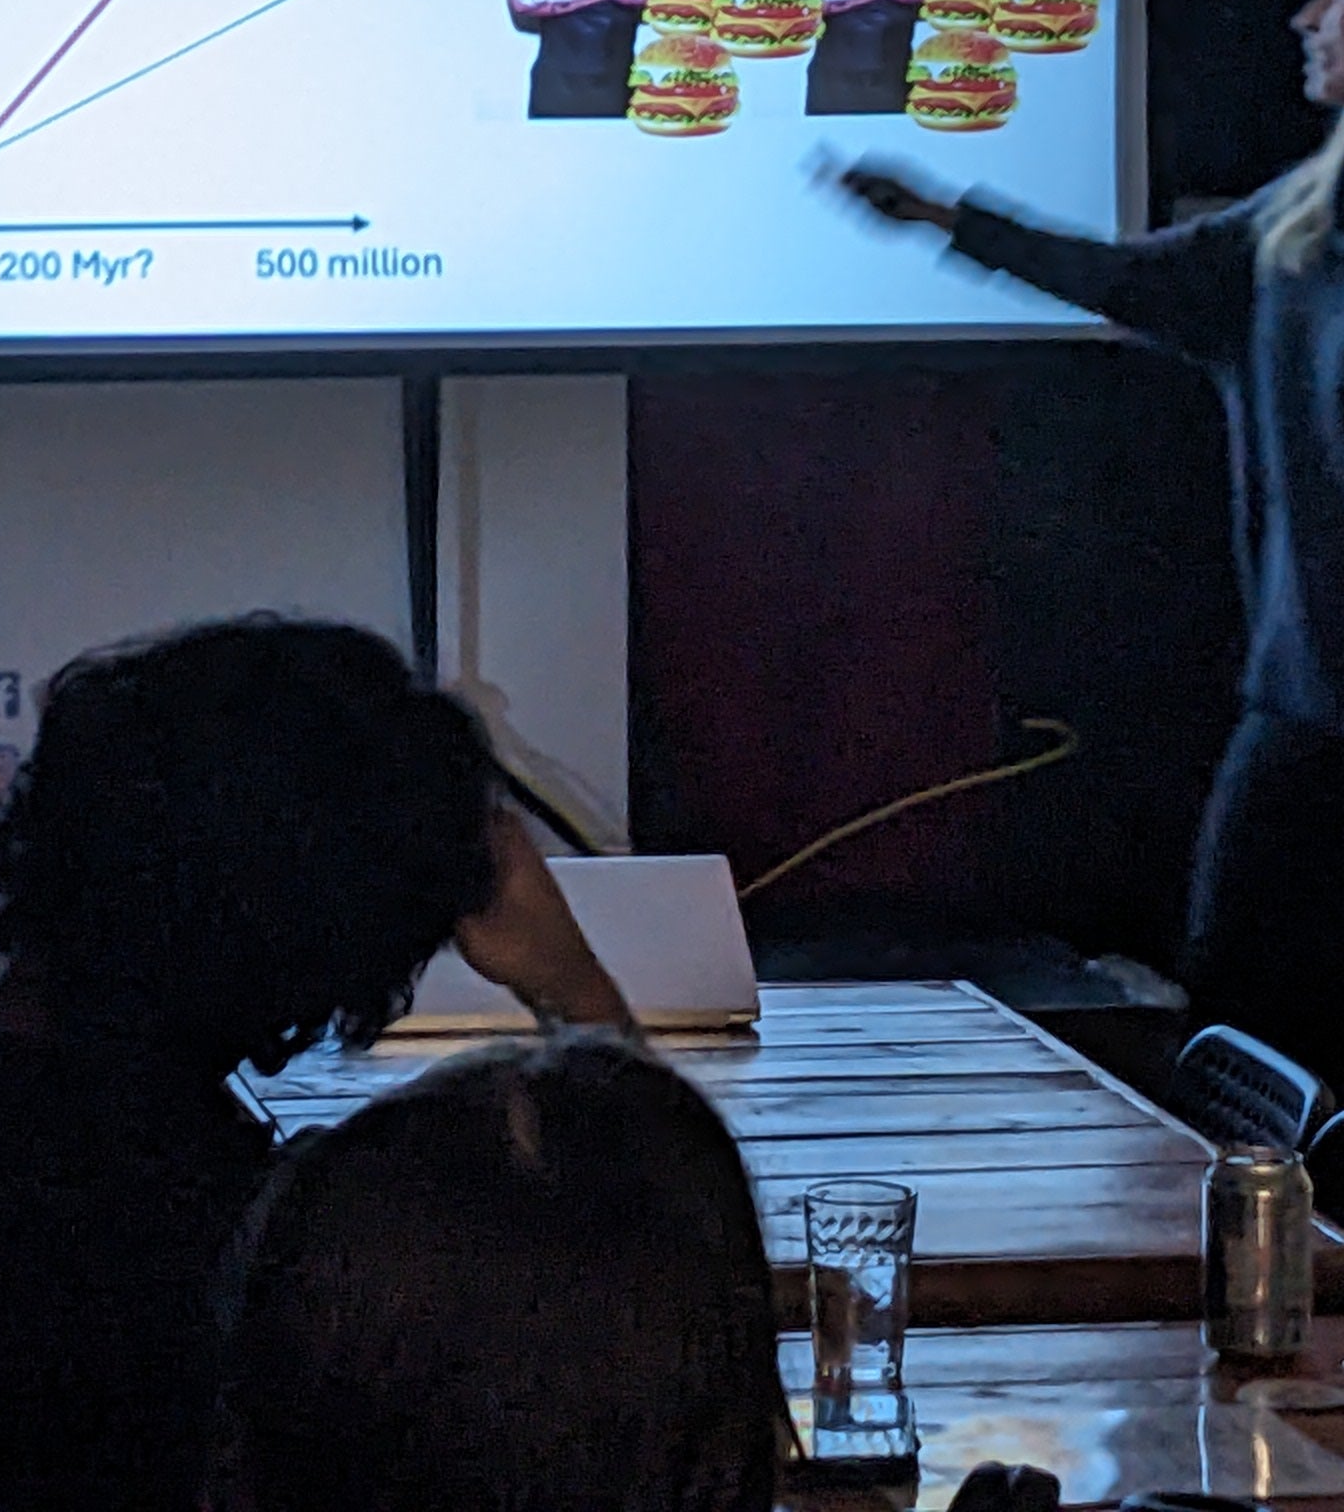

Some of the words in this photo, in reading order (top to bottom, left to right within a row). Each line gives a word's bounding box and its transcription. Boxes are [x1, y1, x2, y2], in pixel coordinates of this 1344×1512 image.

[72, 248, 155, 287] Myr?
[256, 248, 319, 278] 500
[327, 246, 444, 278] million
